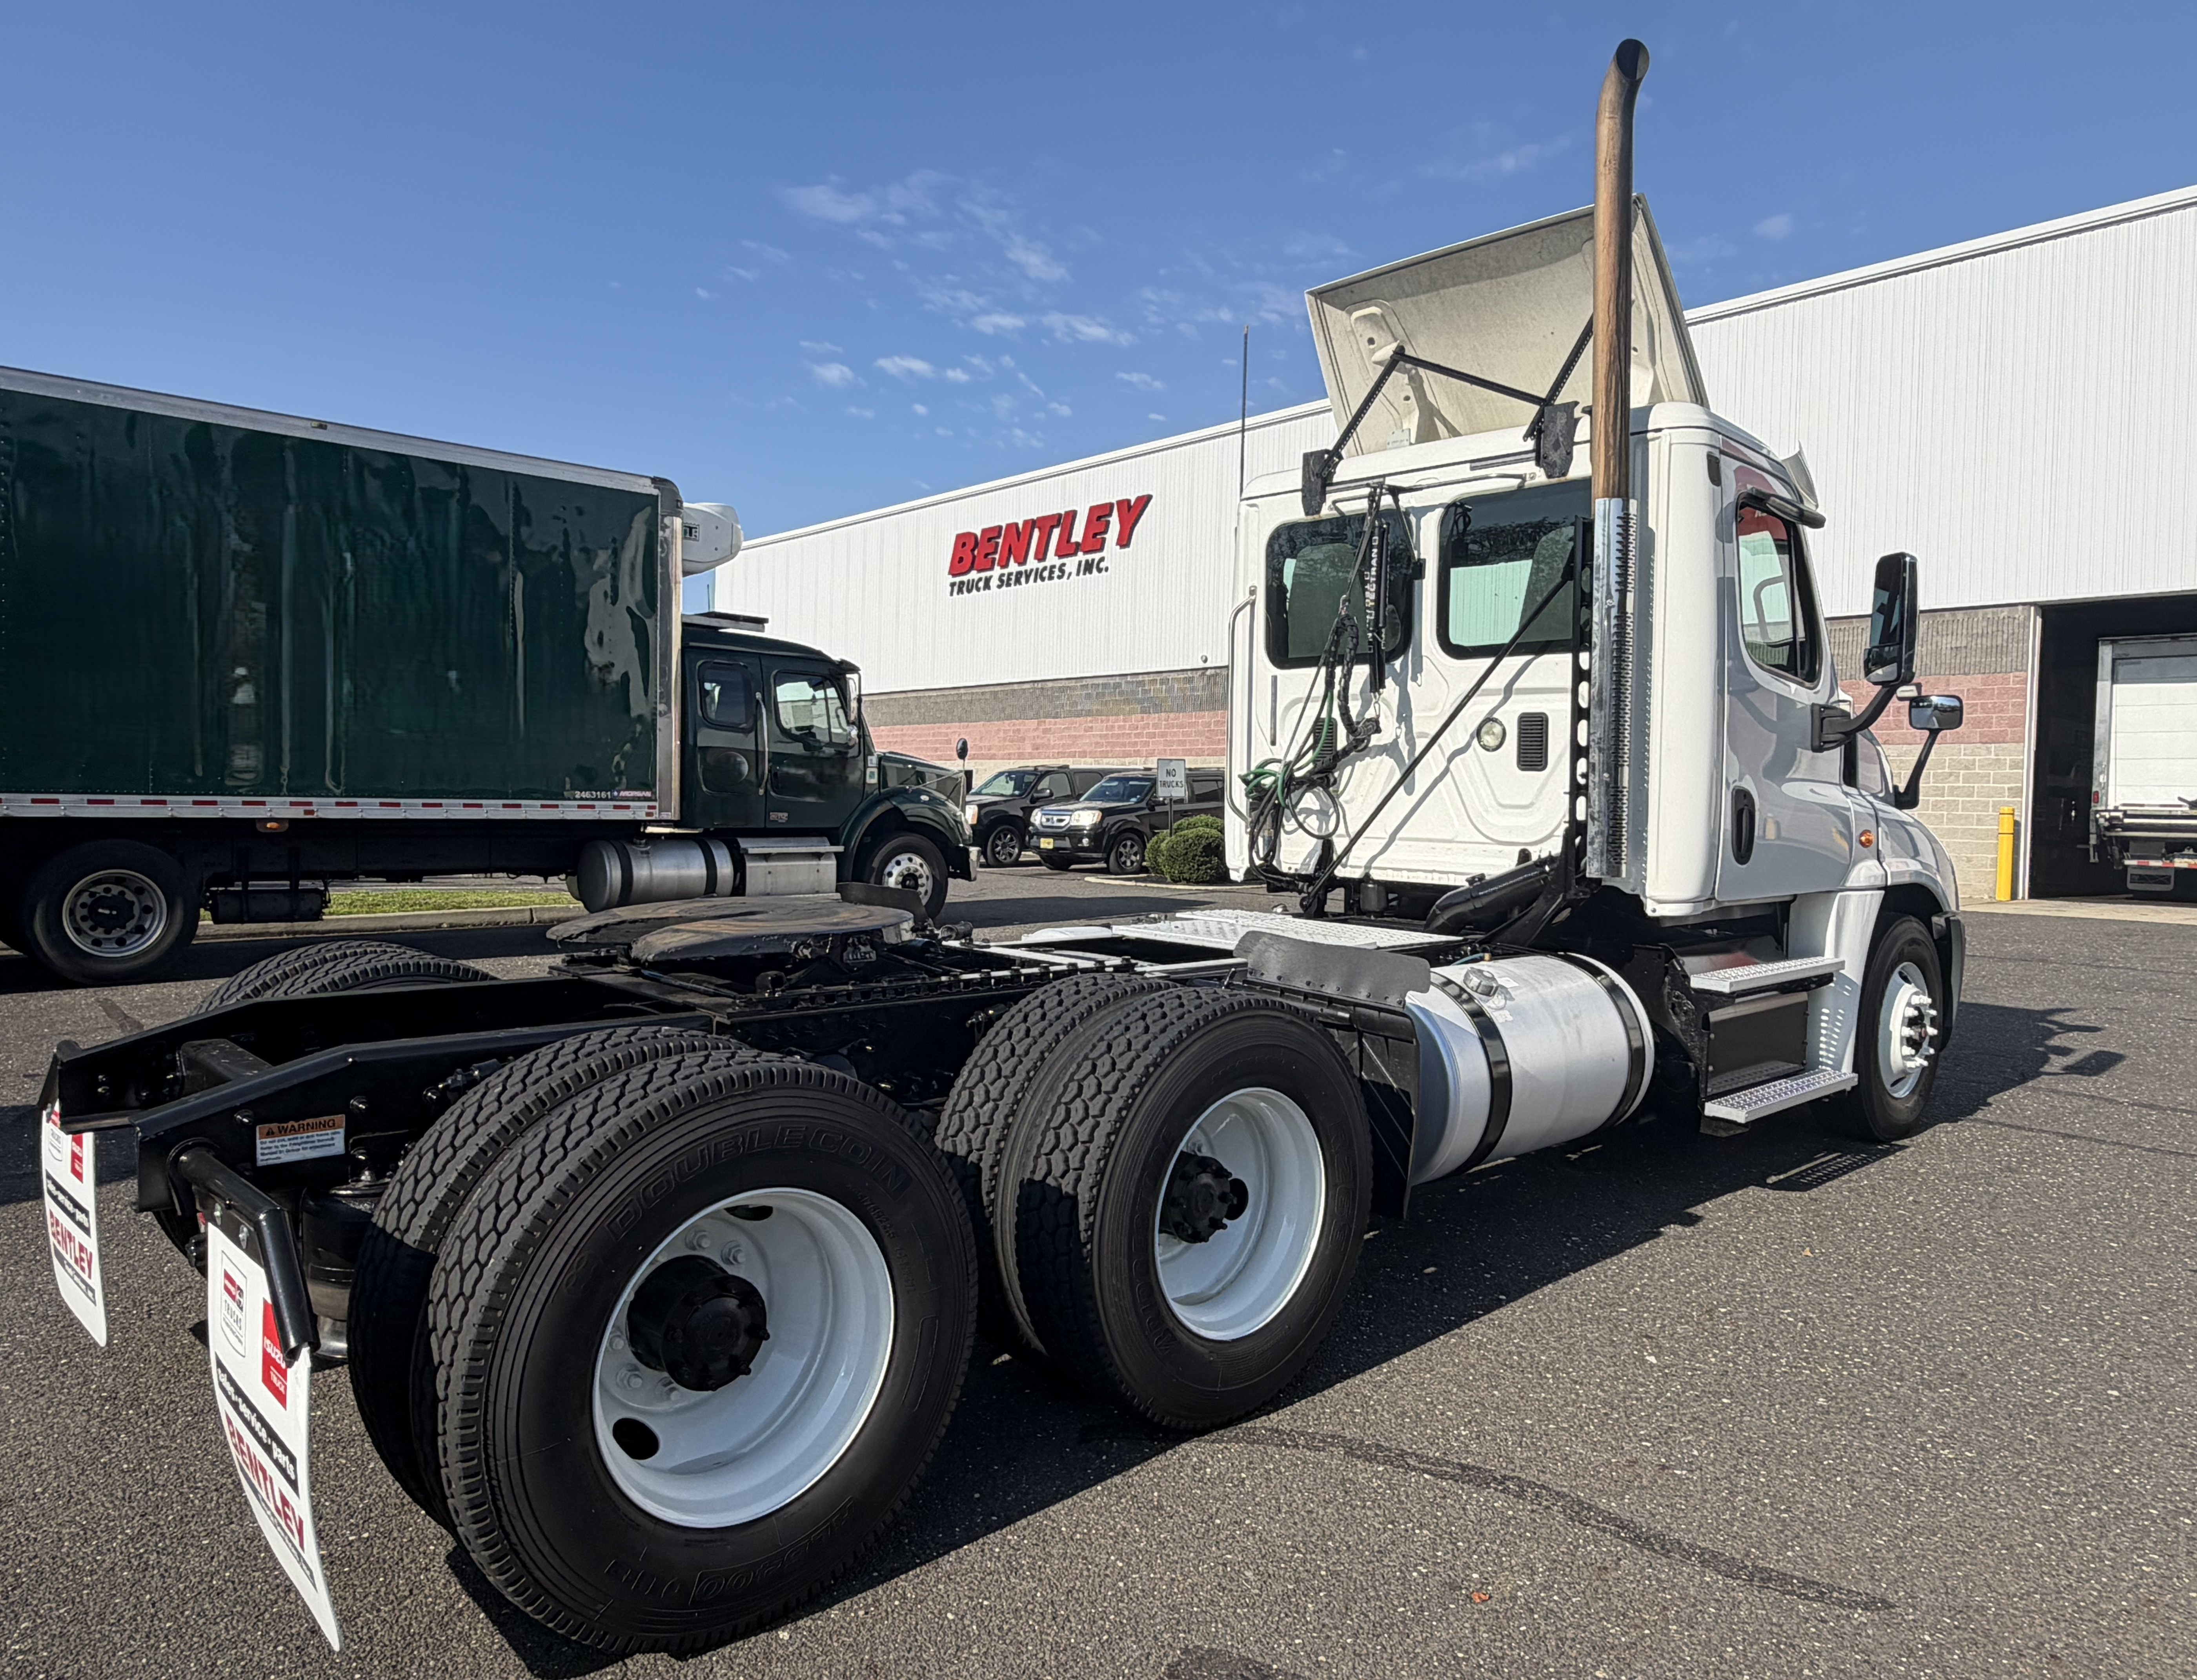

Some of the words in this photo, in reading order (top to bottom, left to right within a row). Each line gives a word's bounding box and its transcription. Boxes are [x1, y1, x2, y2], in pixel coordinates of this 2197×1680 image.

[948, 494, 1153, 577] BENTLEY
[949, 575, 993, 596] TRUCK
[996, 562, 1072, 589] SERVICES,
[1076, 556, 1109, 576] INC.
[1159, 780, 1184, 788] TRUCKS
[1166, 768, 1176, 777] NO
[277, 1118, 336, 1134] WARNING
[49, 1208, 93, 1280] BENTLEY
[238, 1397, 267, 1444] service
[271, 1440, 295, 1480] parts
[225, 1410, 305, 1554] BENTLEY
